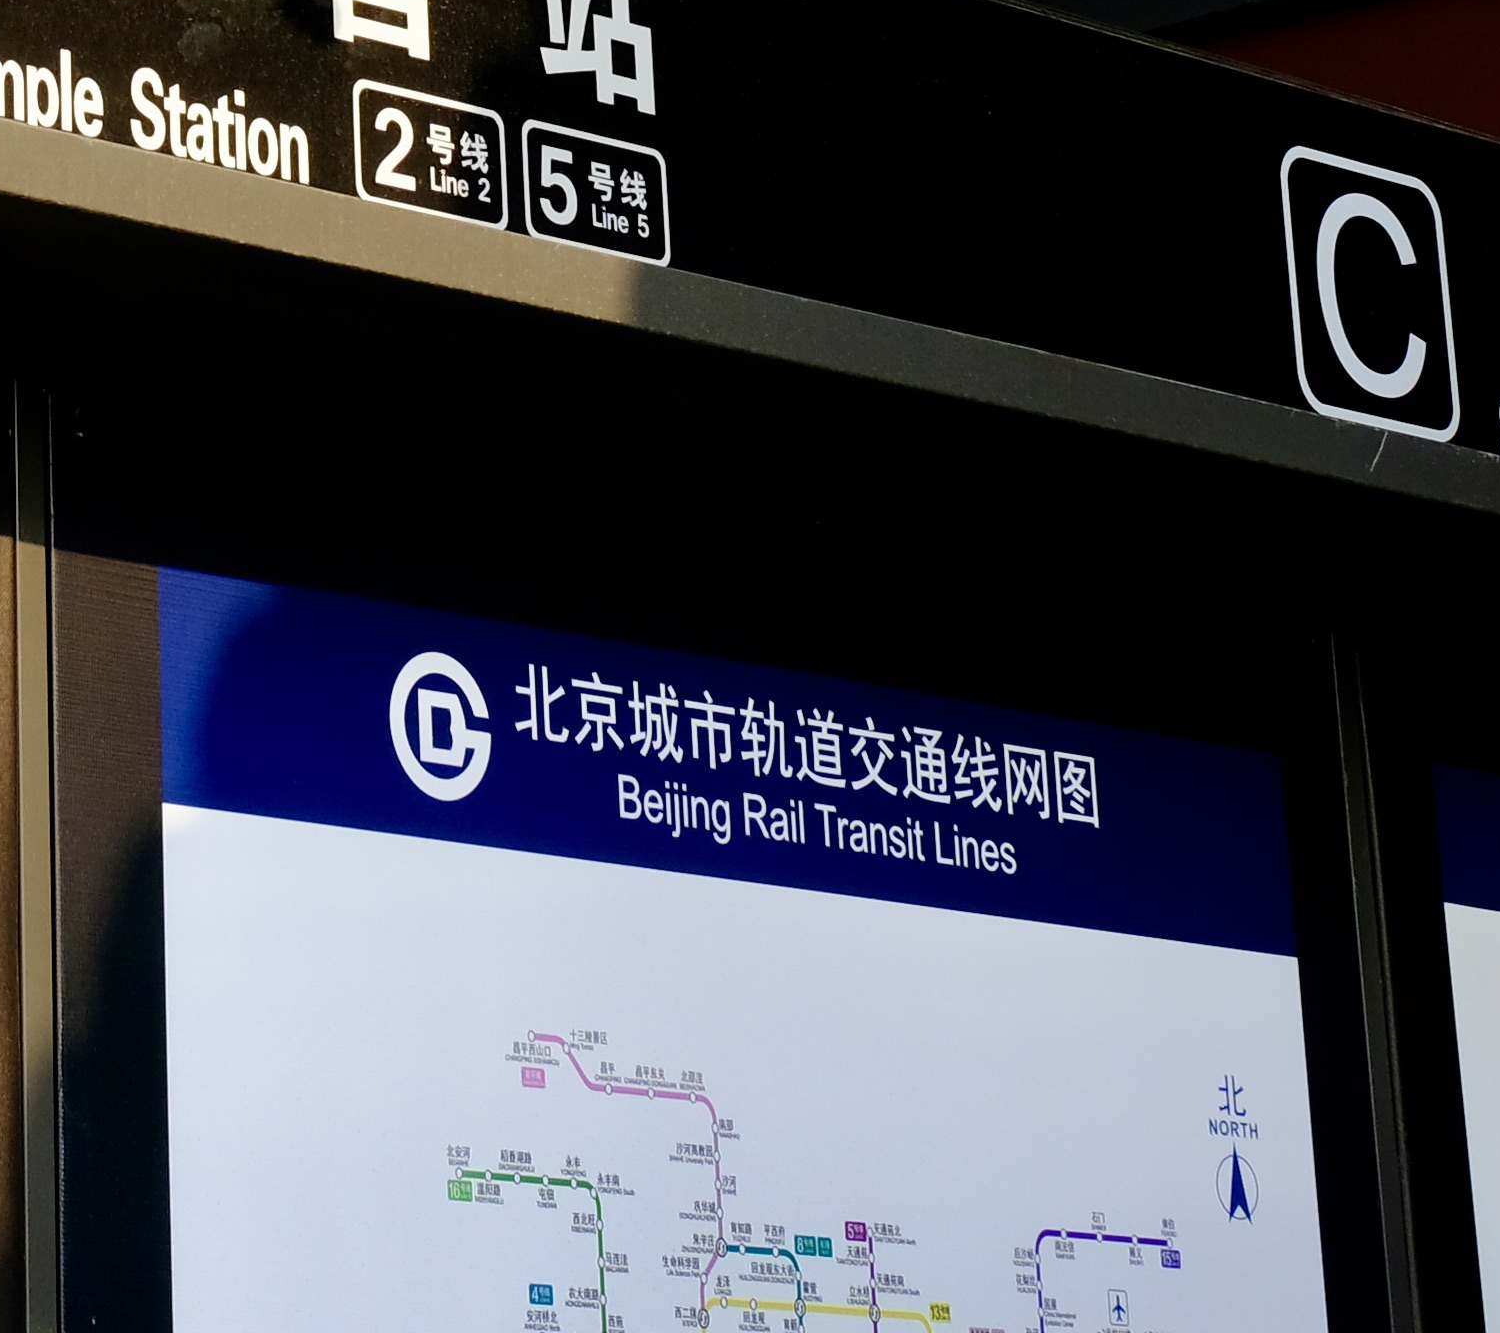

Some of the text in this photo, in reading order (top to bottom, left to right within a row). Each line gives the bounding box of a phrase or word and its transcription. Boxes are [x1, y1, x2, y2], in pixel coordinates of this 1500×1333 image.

[130, 66, 310, 185] Station
[429, 166, 492, 204] Line 2
[591, 203, 650, 239] Line 5
[1316, 192, 1427, 399] C
[514, 663, 1101, 830] 北京城市轨道交通线网图
[617, 773, 1019, 876] Beijing Rail Transit Lines
[1208, 1119, 1260, 1140] NORTH
[1217, 1074, 1247, 1118] 北
